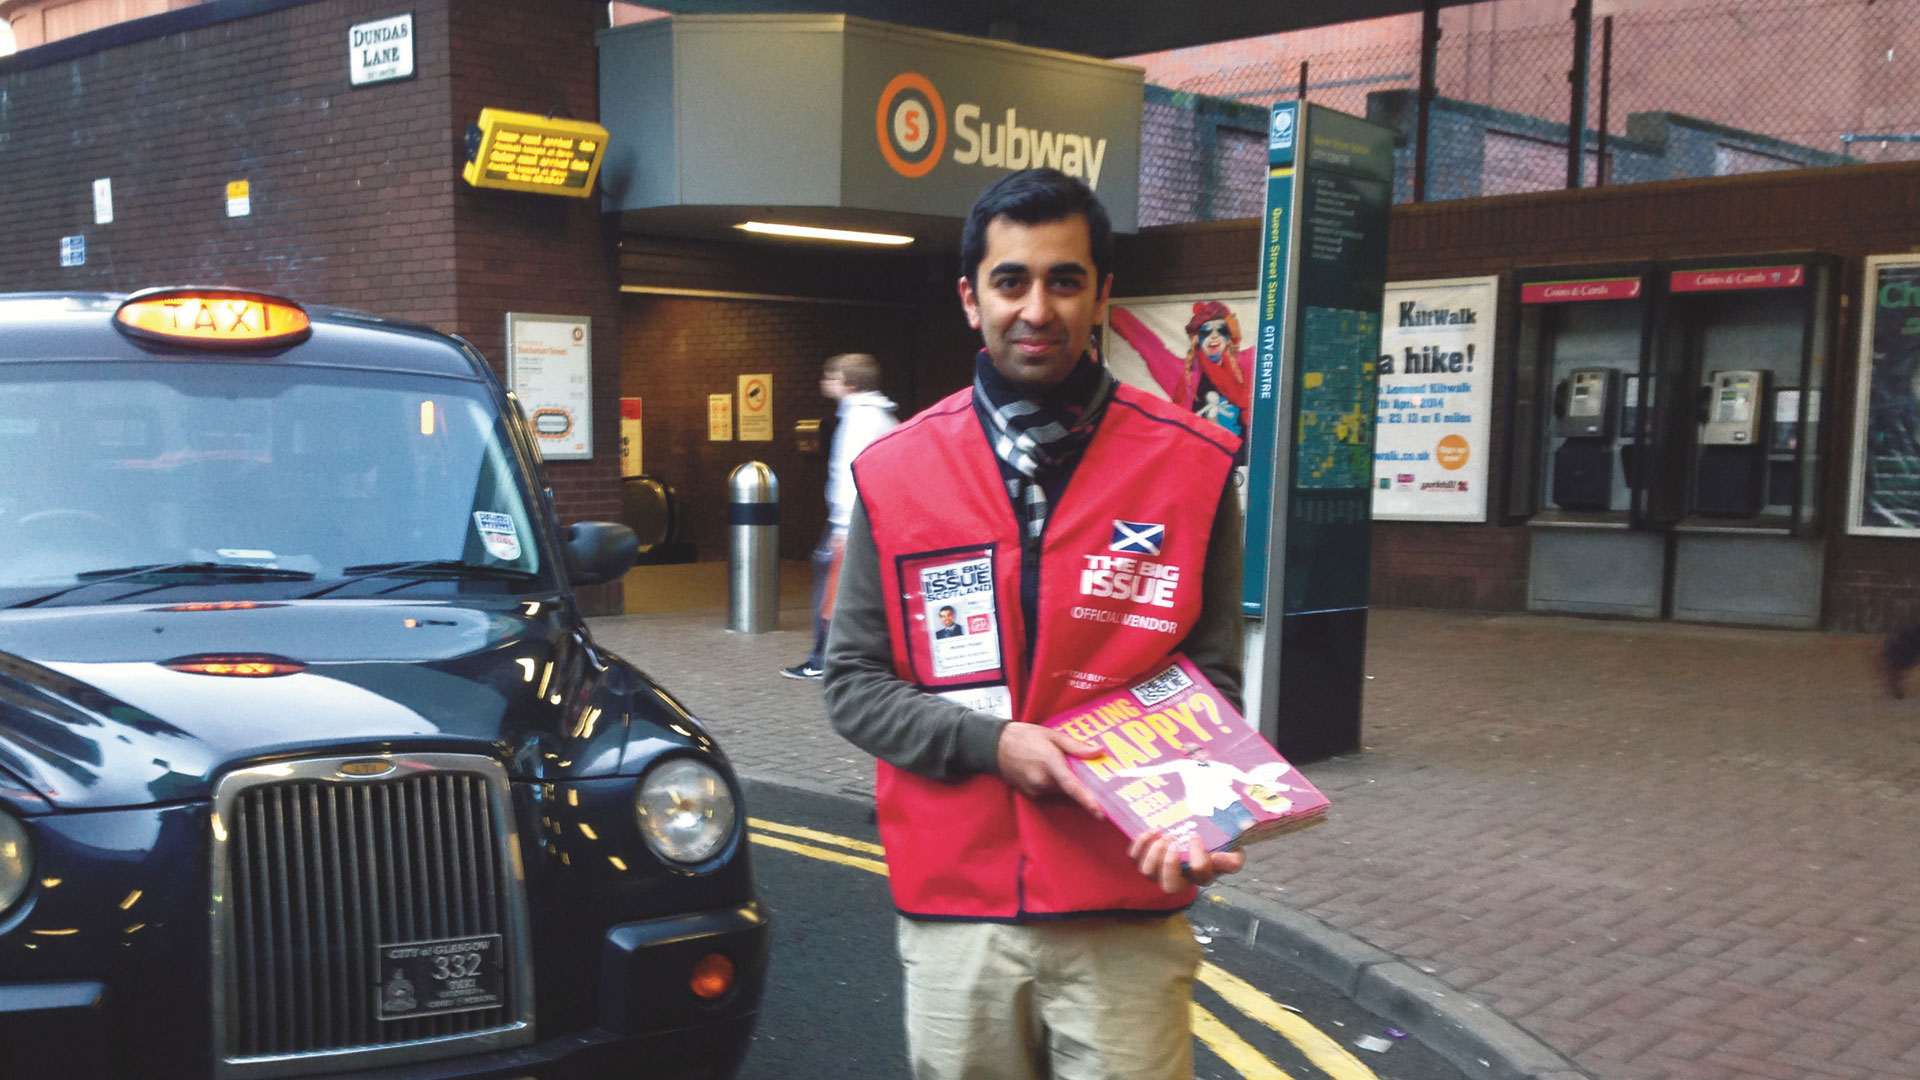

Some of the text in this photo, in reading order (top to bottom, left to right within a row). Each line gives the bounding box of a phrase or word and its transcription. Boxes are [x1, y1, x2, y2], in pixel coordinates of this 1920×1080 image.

[354, 24, 408, 47] DUNDAS
[363, 47, 400, 67] LANE
[905, 110, 920, 141] S
[953, 103, 1107, 191] Subway
[1260, 207, 1283, 399] Queen Street Station CITY CENTRE
[164, 303, 270, 332] TAXI
[1379, 343, 1475, 375] a hike!
[924, 562, 990, 580] THE BIG
[1082, 554, 1180, 581] THE BIG
[925, 569, 991, 594] ISSUE
[926, 583, 992, 602] SCOTLAND
[1080, 568, 1178, 609] ISSUE
[1071, 605, 1178, 634] OFFICIAL VENDOR
[1142, 675, 1188, 702] ISSUE
[1056, 698, 1142, 742] EELING
[387, 948, 420, 959] CITY
[433, 941, 490, 955] GLASGOW
[431, 953, 482, 980] 332
